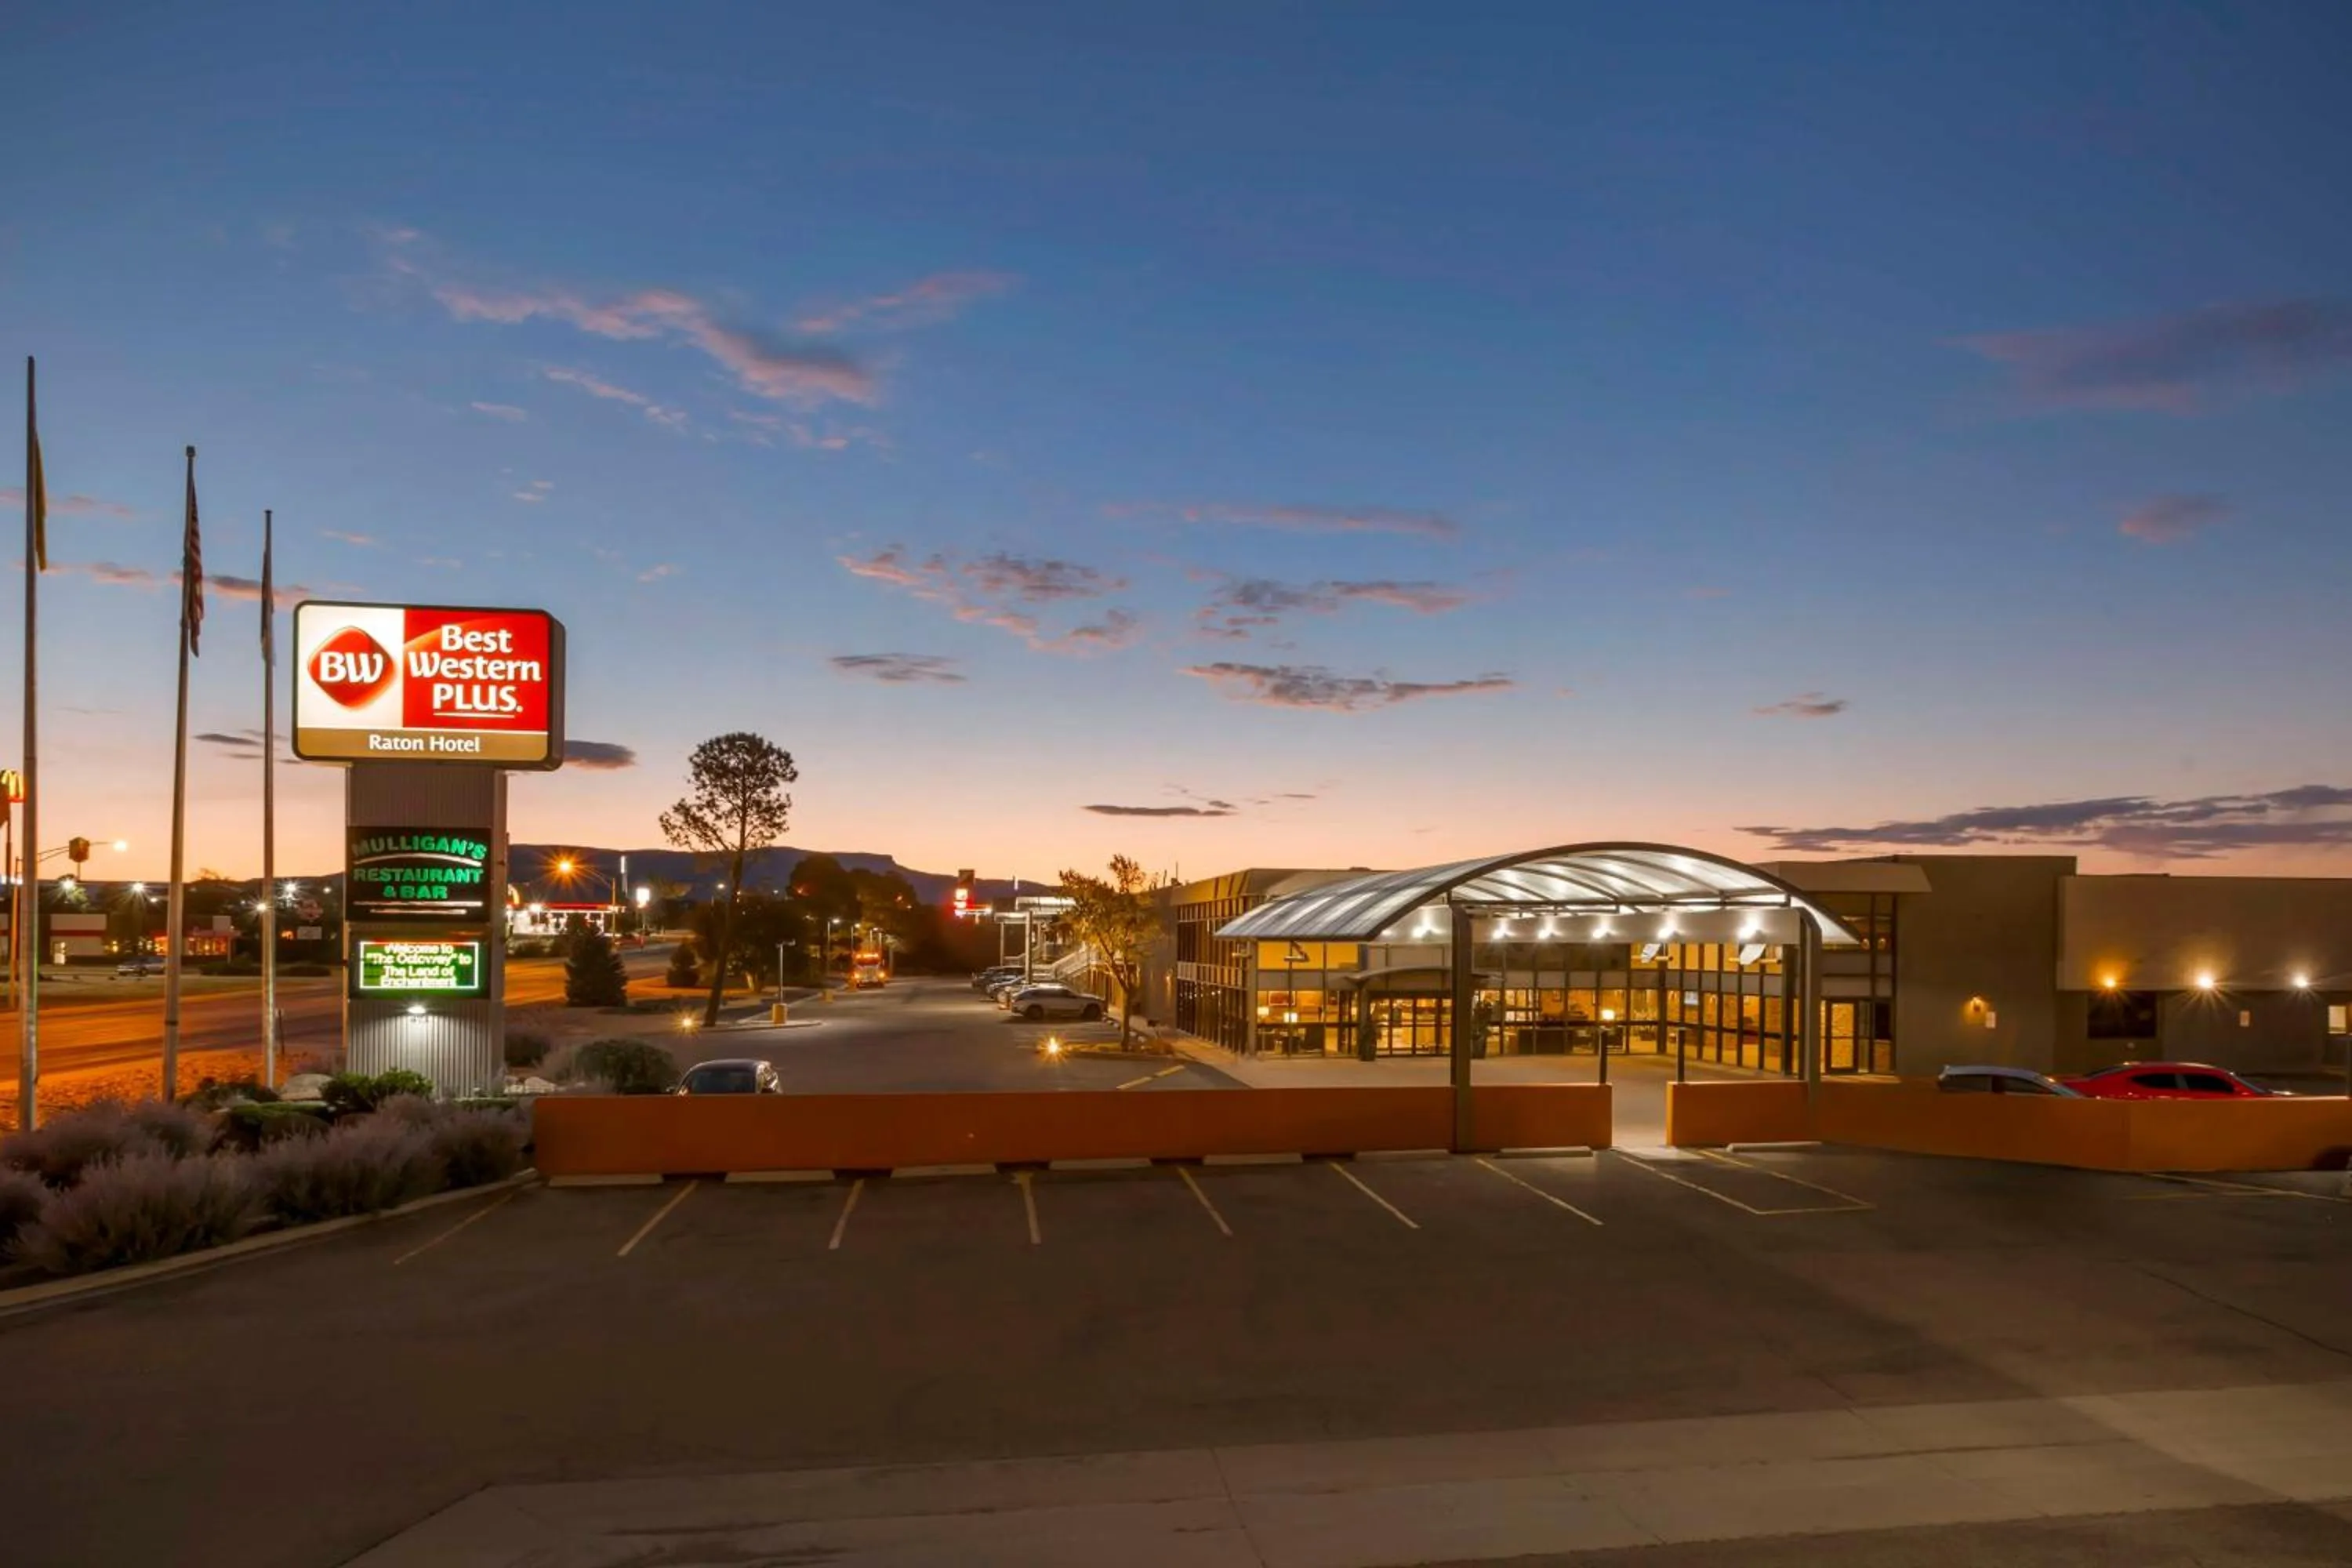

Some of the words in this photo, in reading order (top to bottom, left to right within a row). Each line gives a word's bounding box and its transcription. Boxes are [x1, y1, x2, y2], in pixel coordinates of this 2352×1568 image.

[441, 624, 513, 653] Best
[319, 652, 383, 684] BW
[408, 652, 542, 681] Western
[368, 734, 424, 751] Raton
[430, 736, 481, 753] Hotel
[353, 836, 487, 859] MULLIGAN'S
[354, 868, 483, 883] RESTAURANT
[383, 885, 396, 898] &
[400, 885, 448, 898] BAR
[383, 966, 405, 976] The
